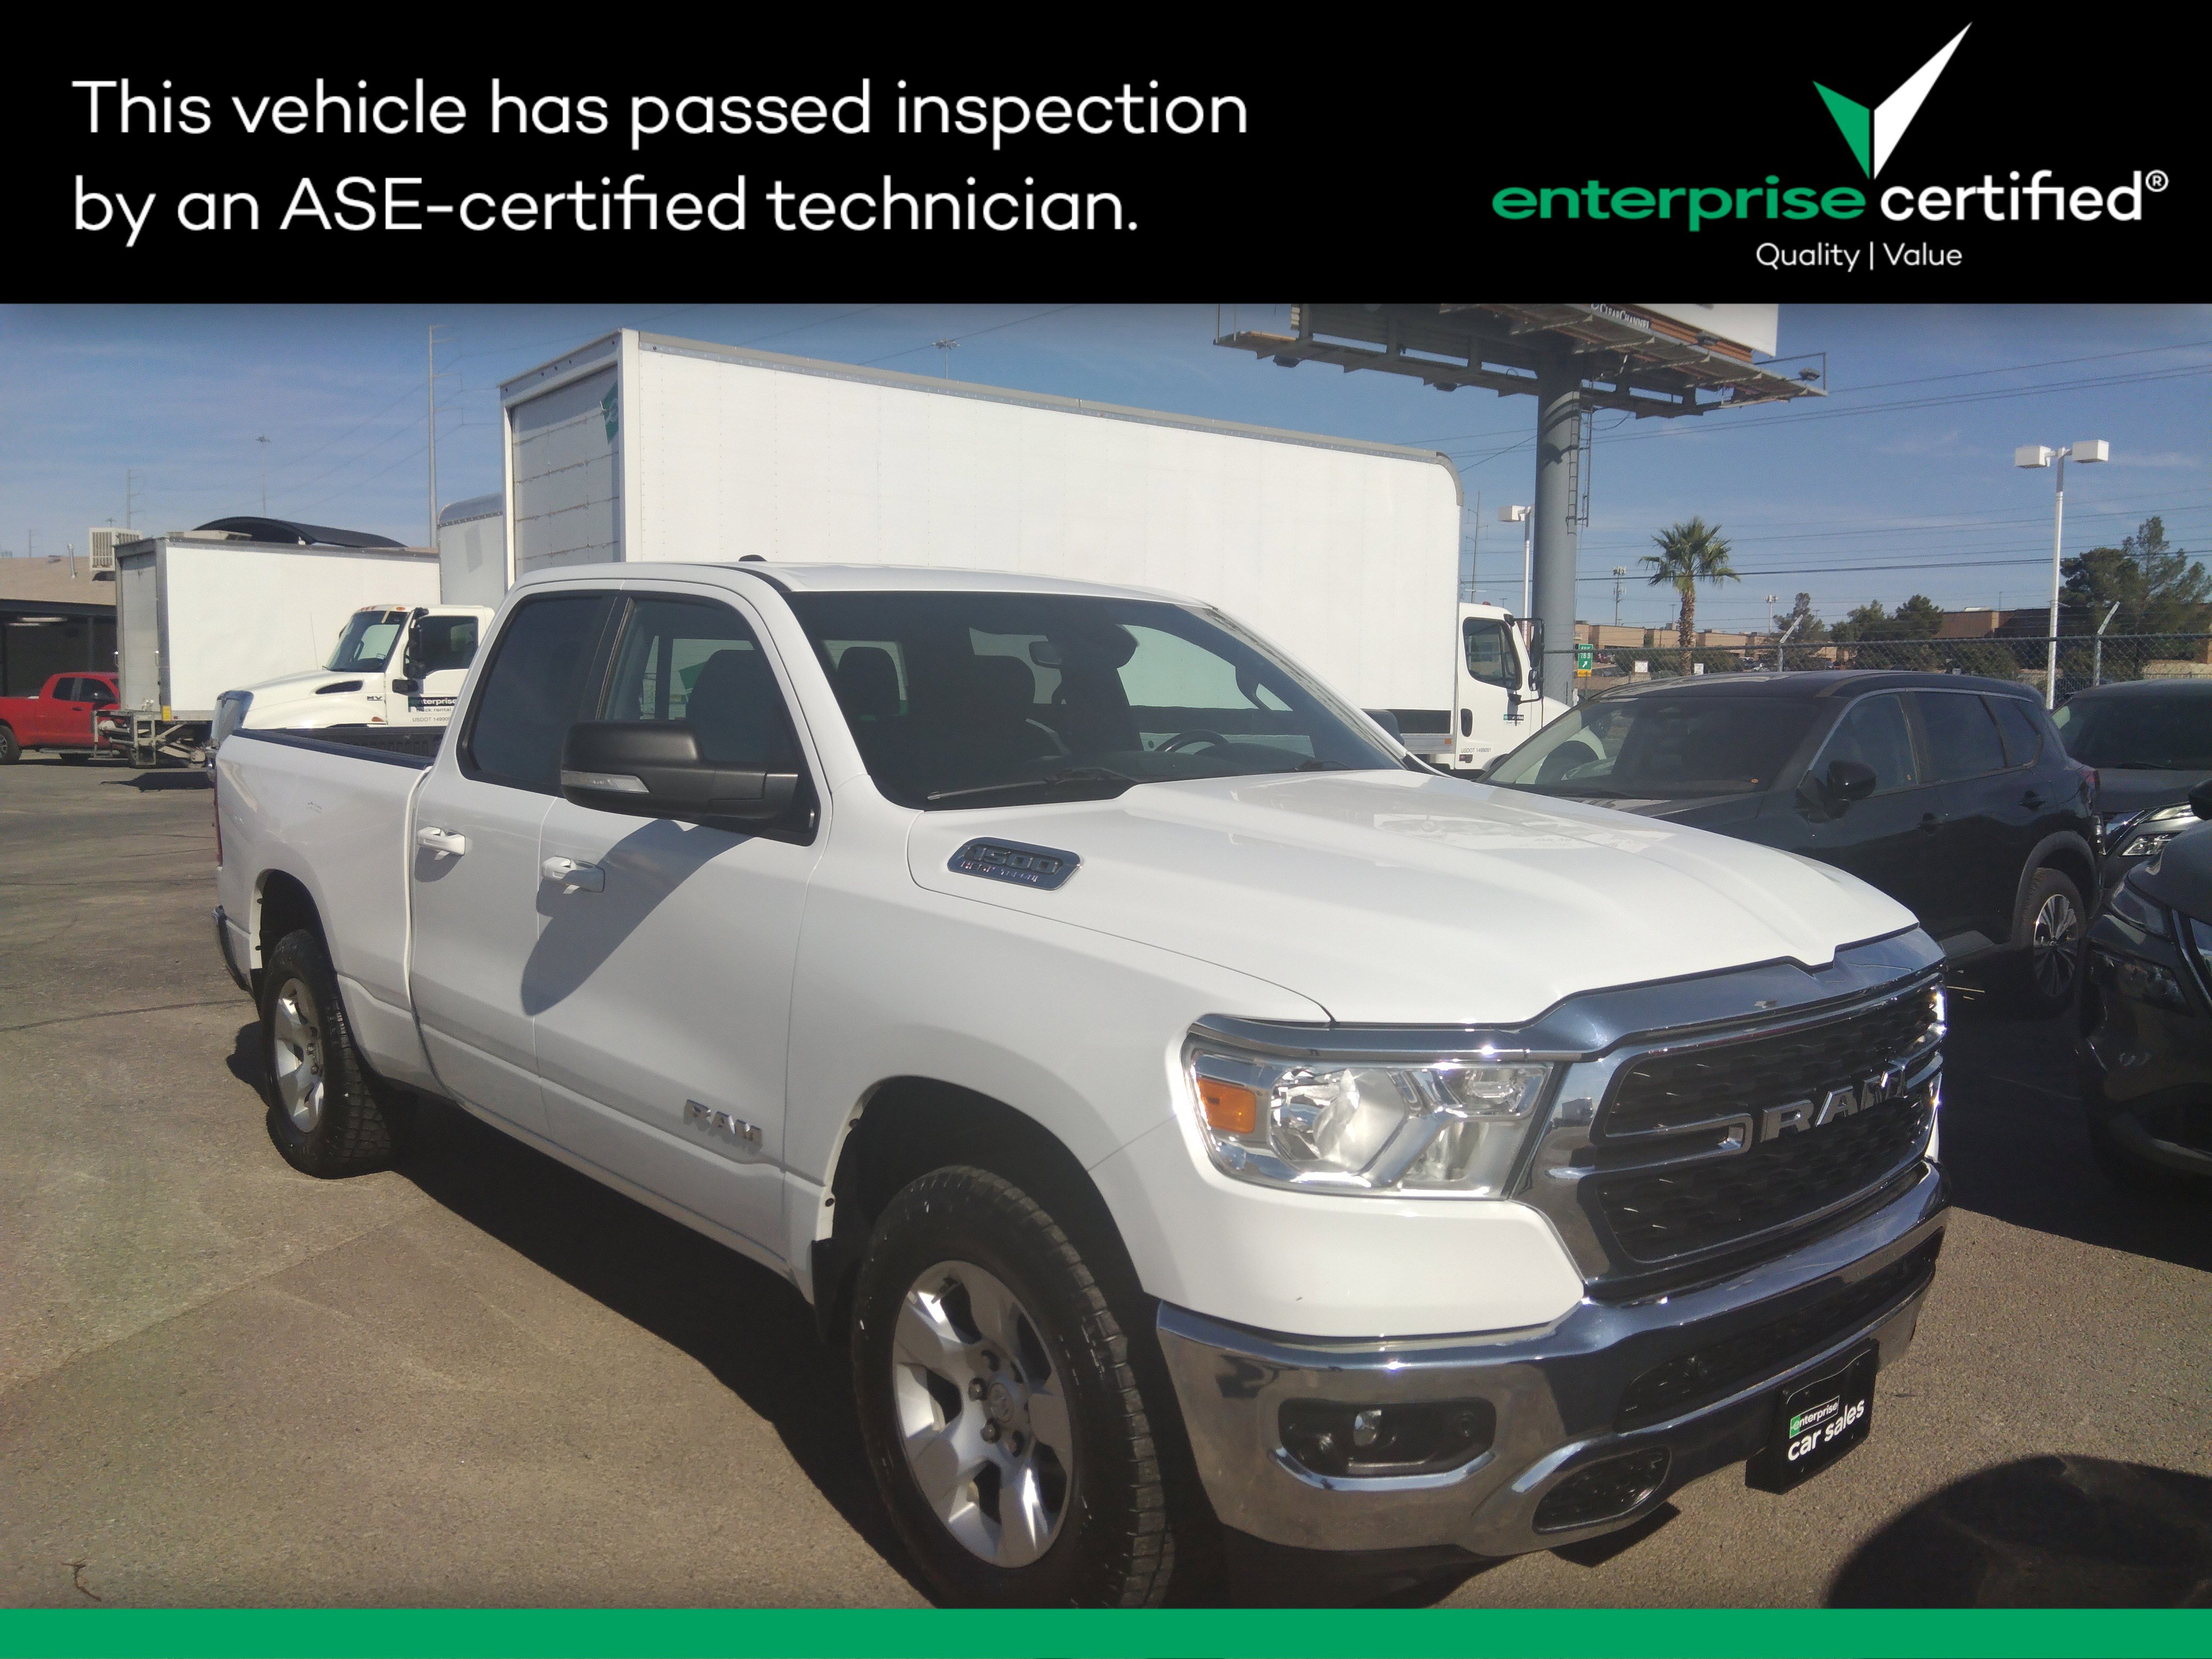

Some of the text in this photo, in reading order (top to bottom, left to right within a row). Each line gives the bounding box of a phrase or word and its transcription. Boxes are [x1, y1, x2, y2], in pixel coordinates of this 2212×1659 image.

[683, 1099, 764, 1154] RAM
[1760, 1059, 1907, 1143] RAM
[1788, 1399, 1865, 1461] car sales
[1791, 1401, 1839, 1430] enterprise
